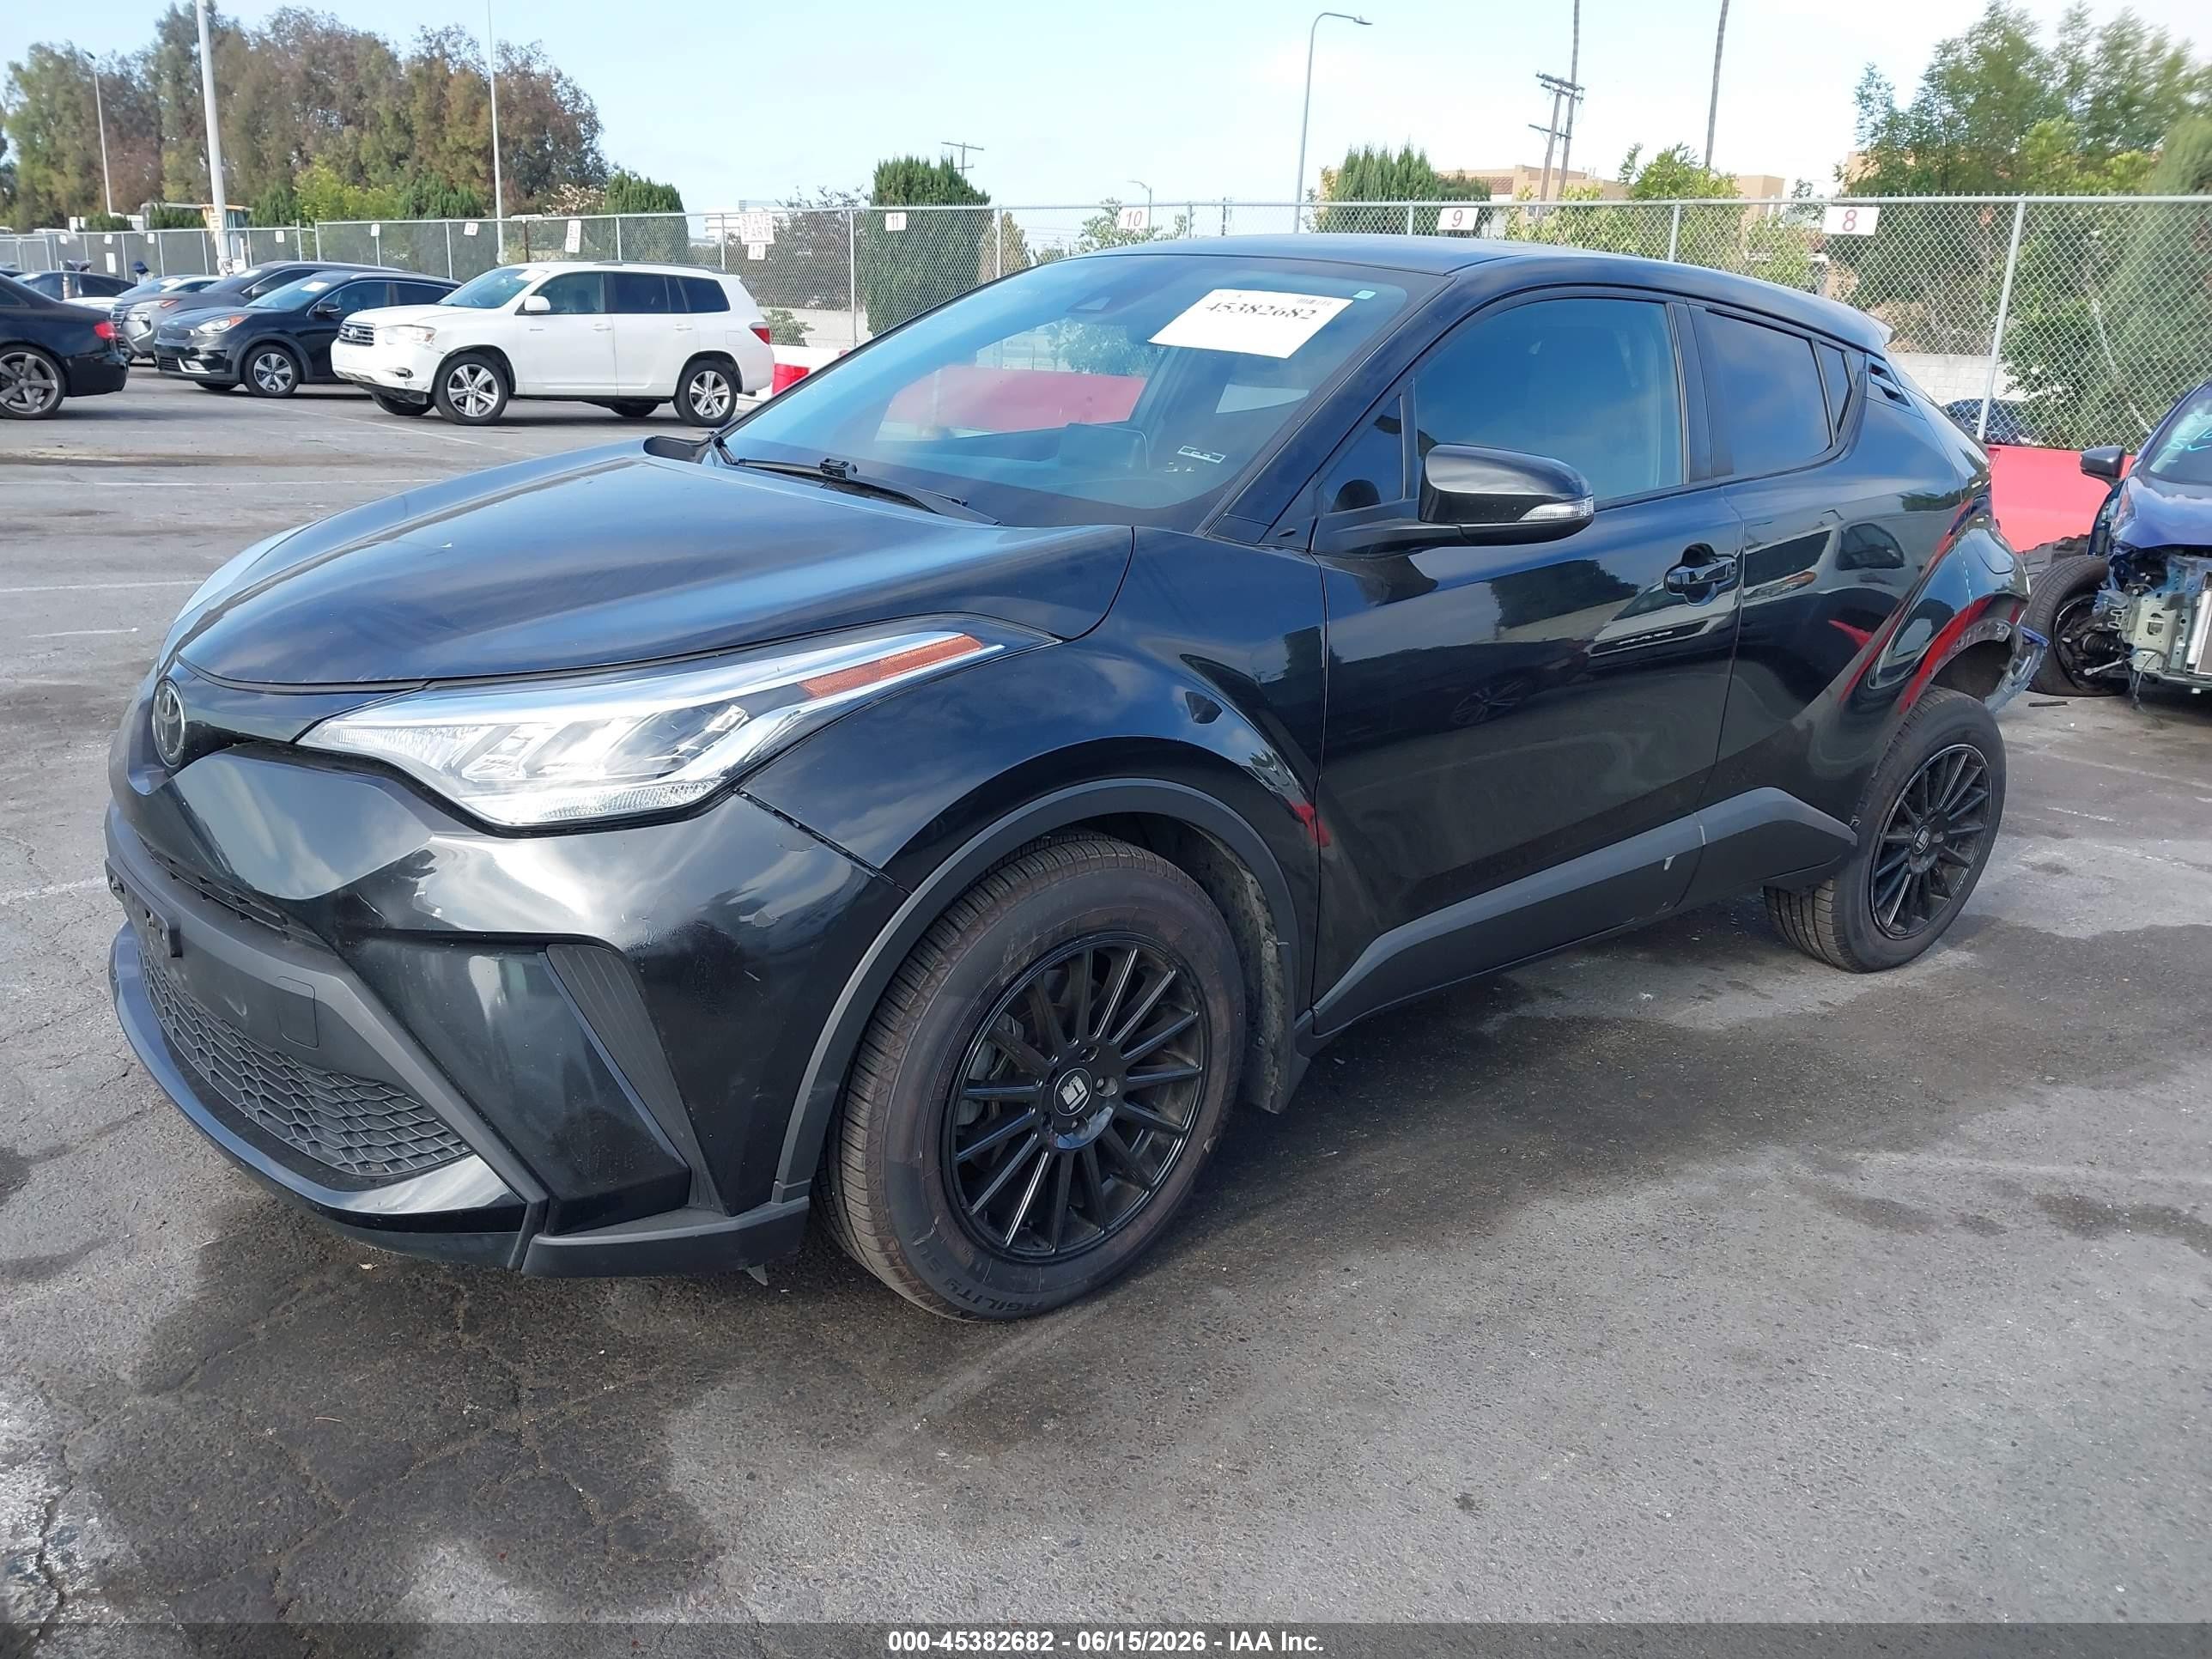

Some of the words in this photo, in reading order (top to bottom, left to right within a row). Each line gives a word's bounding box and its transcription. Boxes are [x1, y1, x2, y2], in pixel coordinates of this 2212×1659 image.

[741, 213, 770, 227] STATE
[890, 214, 899, 228] 11
[1126, 210, 1142, 227] 10
[1451, 210, 1463, 228] 9
[1842, 209, 1857, 232] 8
[752, 244, 763, 258] 12
[1205, 301, 1317, 320] 45382682
